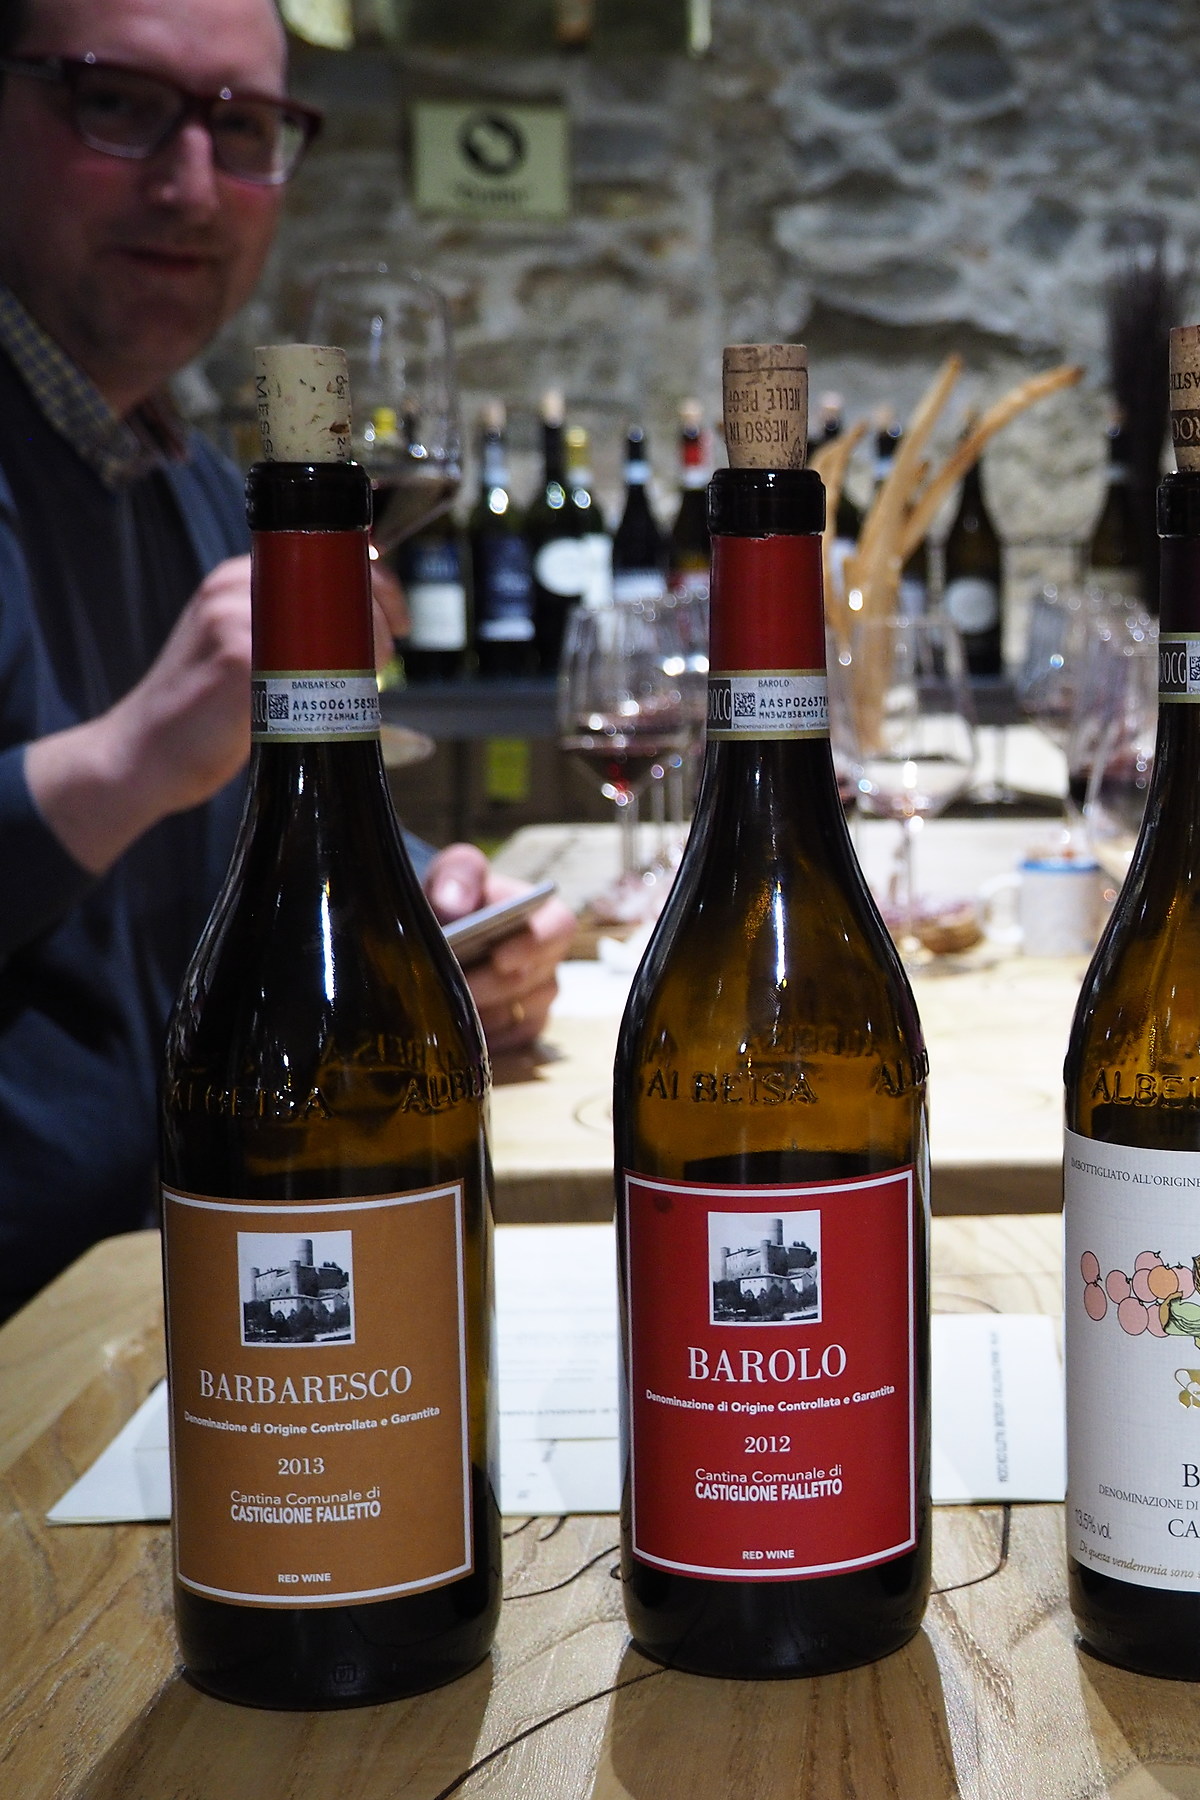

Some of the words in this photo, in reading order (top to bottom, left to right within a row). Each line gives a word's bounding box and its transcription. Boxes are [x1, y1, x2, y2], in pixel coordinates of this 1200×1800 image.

[291, 680, 346, 690] BARBARESCO
[687, 1344, 848, 1384] BAROLO
[200, 1366, 412, 1405] BARBARESCO
[645, 1389, 715, 1412] Denominazione
[717, 1401, 728, 1412] di
[731, 1402, 775, 1415] Origine
[777, 1397, 841, 1412] Controllata
[843, 1397, 850, 1405] e
[852, 1384, 895, 1403] Garantita
[184, 1410, 248, 1433] Denominazione
[250, 1421, 261, 1433] di
[264, 1423, 308, 1436] Origine
[310, 1418, 378, 1434] Controllata
[381, 1417, 388, 1426] e
[390, 1405, 440, 1424] Garantita
[743, 1435, 791, 1453] 2012
[278, 1457, 326, 1476] 2013
[695, 1468, 747, 1483] Cantina
[752, 1466, 825, 1483] Comunale
[829, 1464, 842, 1478] di
[230, 1490, 281, 1505] Cantina
[286, 1488, 361, 1505] Comunale
[366, 1486, 381, 1499] di
[695, 1482, 778, 1501] CASTIGLIONE
[781, 1478, 843, 1500] FALLETTO
[1099, 1484, 1183, 1509] DENOMINAZIONE
[1186, 1500, 1198, 1510] DI
[230, 1504, 312, 1524] CASTIGLIONE
[316, 1501, 381, 1523] FALLETTO
[1098, 1522, 1112, 1540] vol.
[742, 1551, 764, 1560] RED
[766, 1550, 795, 1560] WINE
[1079, 1539, 1088, 1553] Di
[1088, 1547, 1110, 1561] questa
[1112, 1557, 1168, 1576] vendemmia
[1170, 1567, 1194, 1579] sono
[278, 1573, 300, 1583] RED
[302, 1573, 332, 1583] WINE
